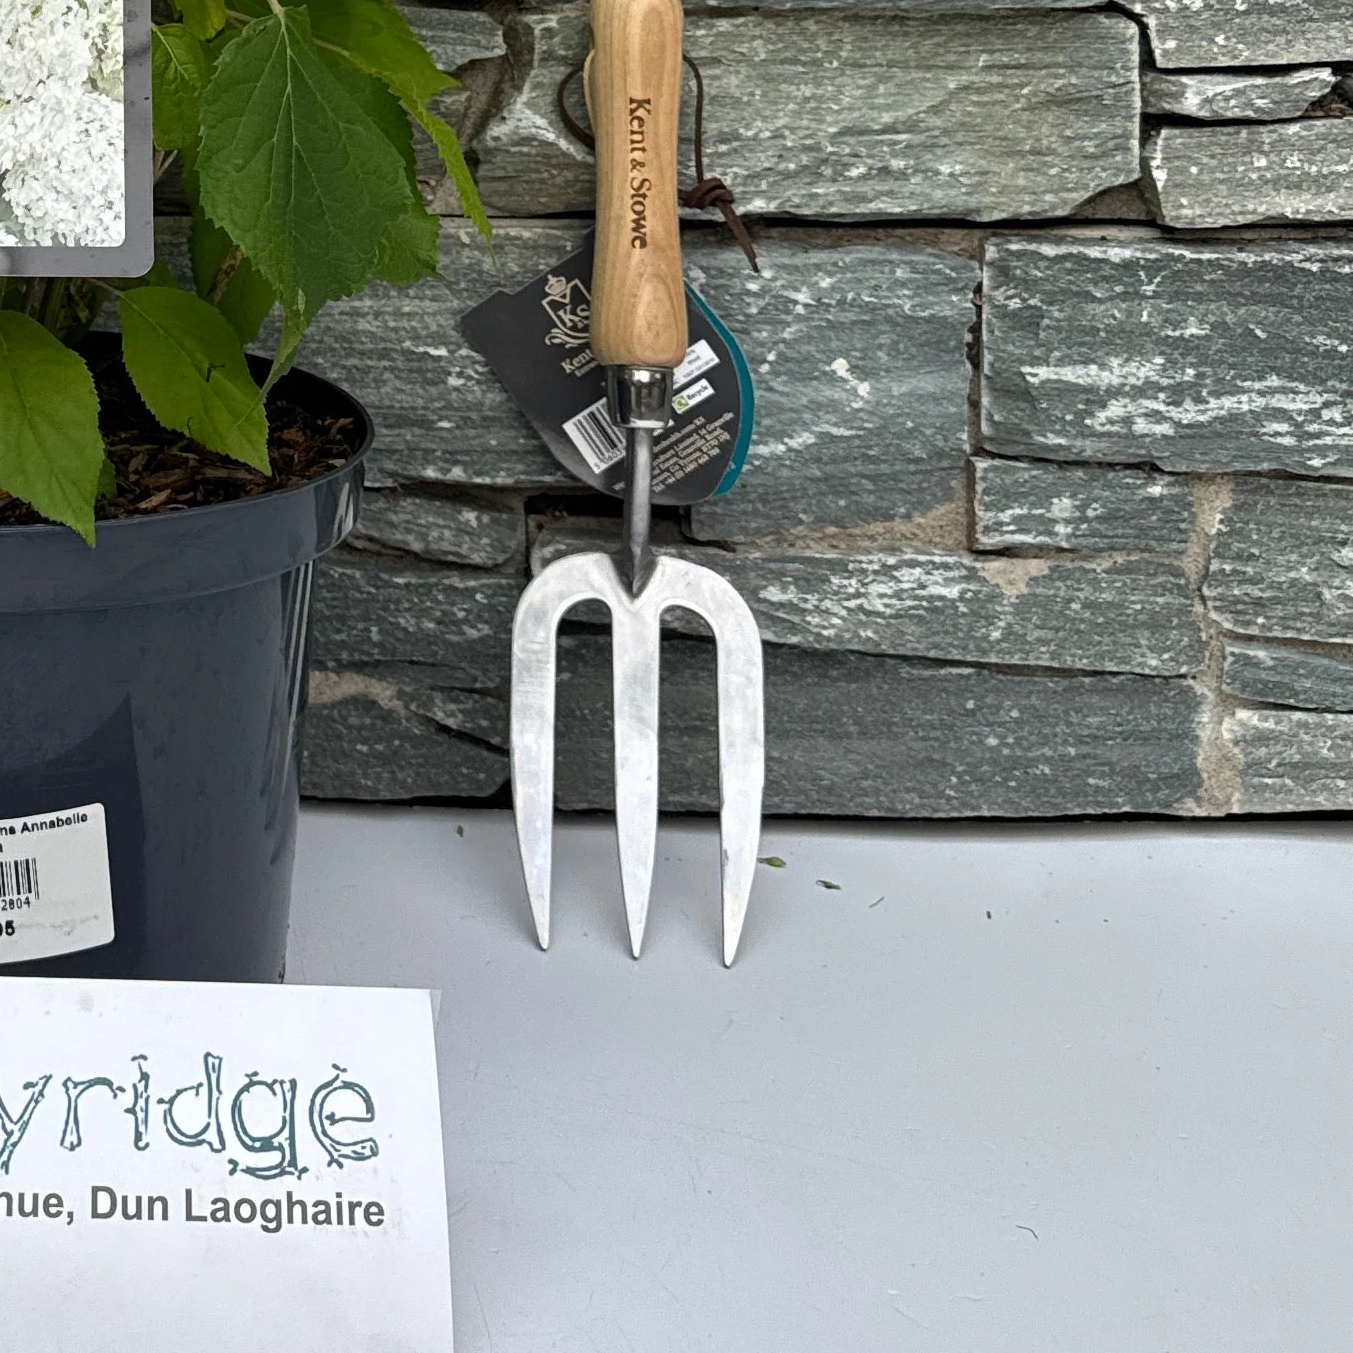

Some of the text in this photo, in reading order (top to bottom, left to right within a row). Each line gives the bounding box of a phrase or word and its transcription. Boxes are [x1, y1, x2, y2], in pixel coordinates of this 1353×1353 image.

[629, 97, 652, 250] Kent & Stowe
[20, 812, 88, 834] Annabelle
[90, 1185, 169, 1221] Dun
[185, 1188, 386, 1234] Laoghaire
